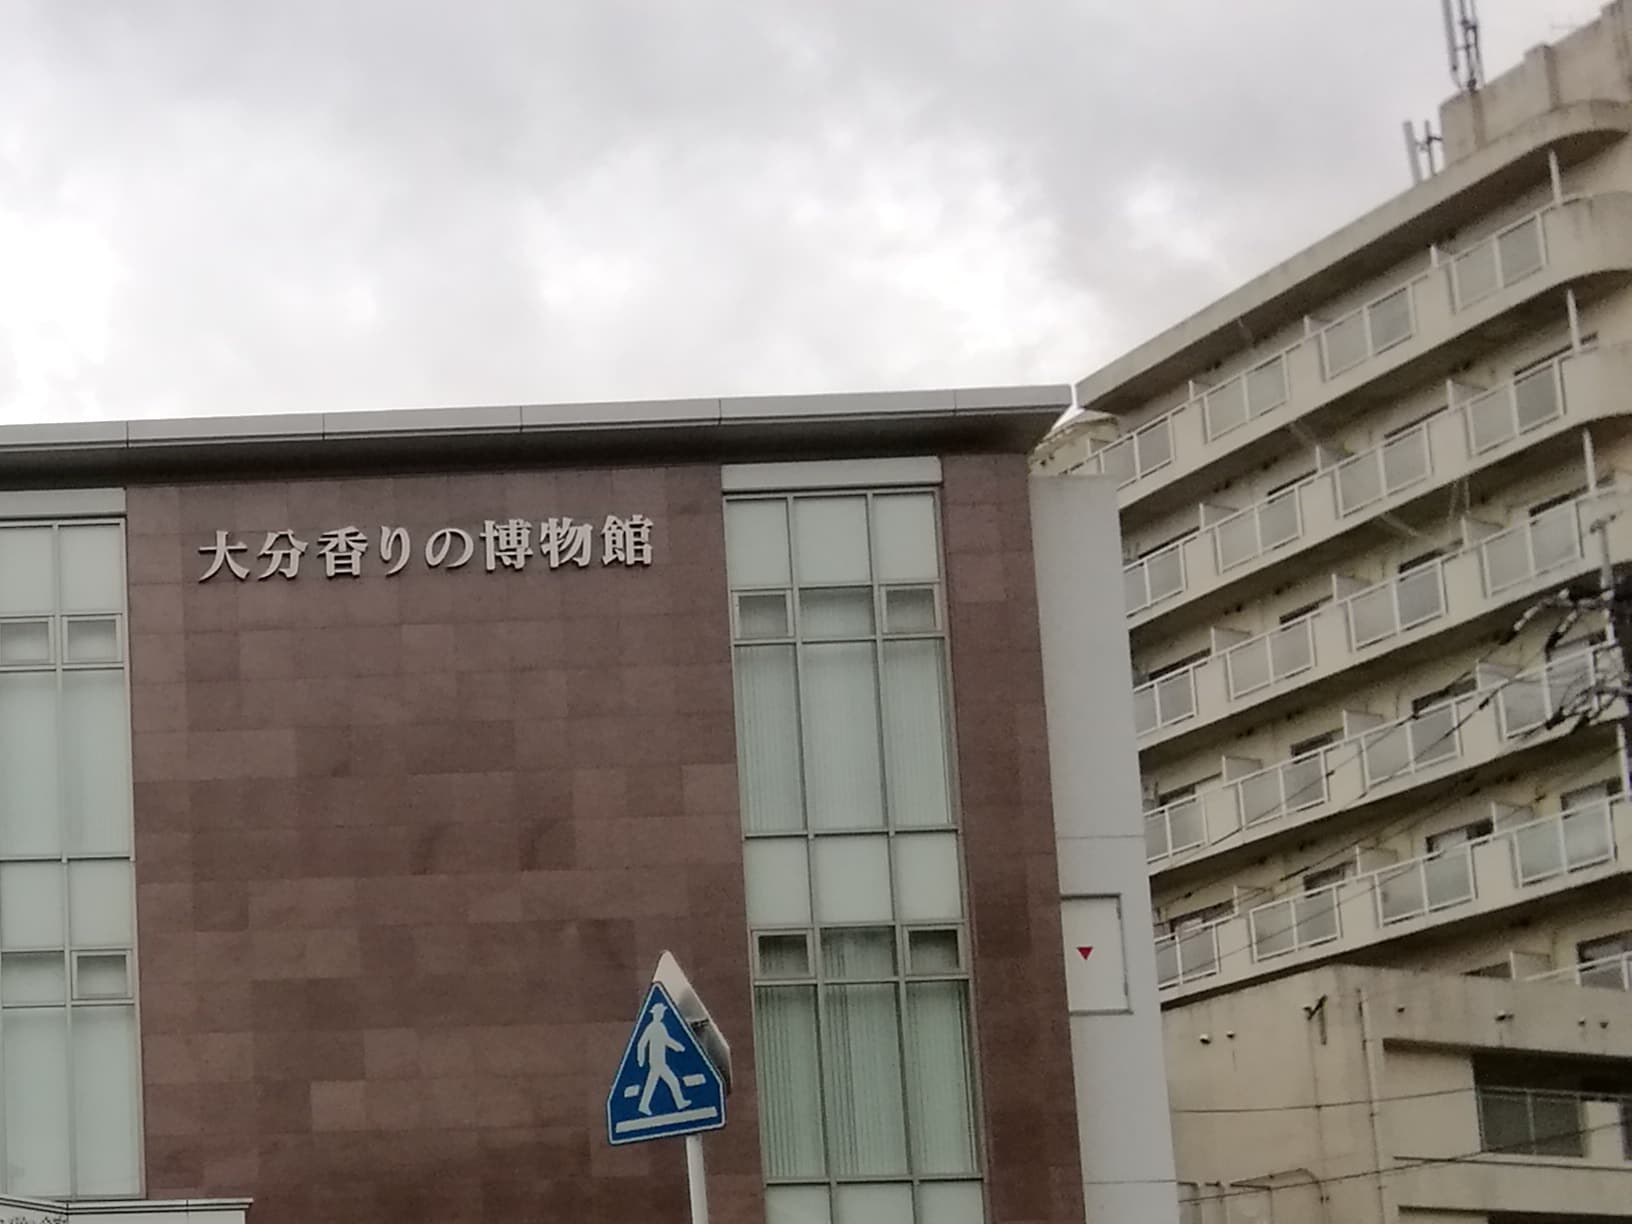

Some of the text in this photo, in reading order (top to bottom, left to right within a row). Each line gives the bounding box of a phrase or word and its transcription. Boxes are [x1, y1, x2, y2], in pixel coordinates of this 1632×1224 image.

[198, 513, 655, 583] 大分香りの博物館
